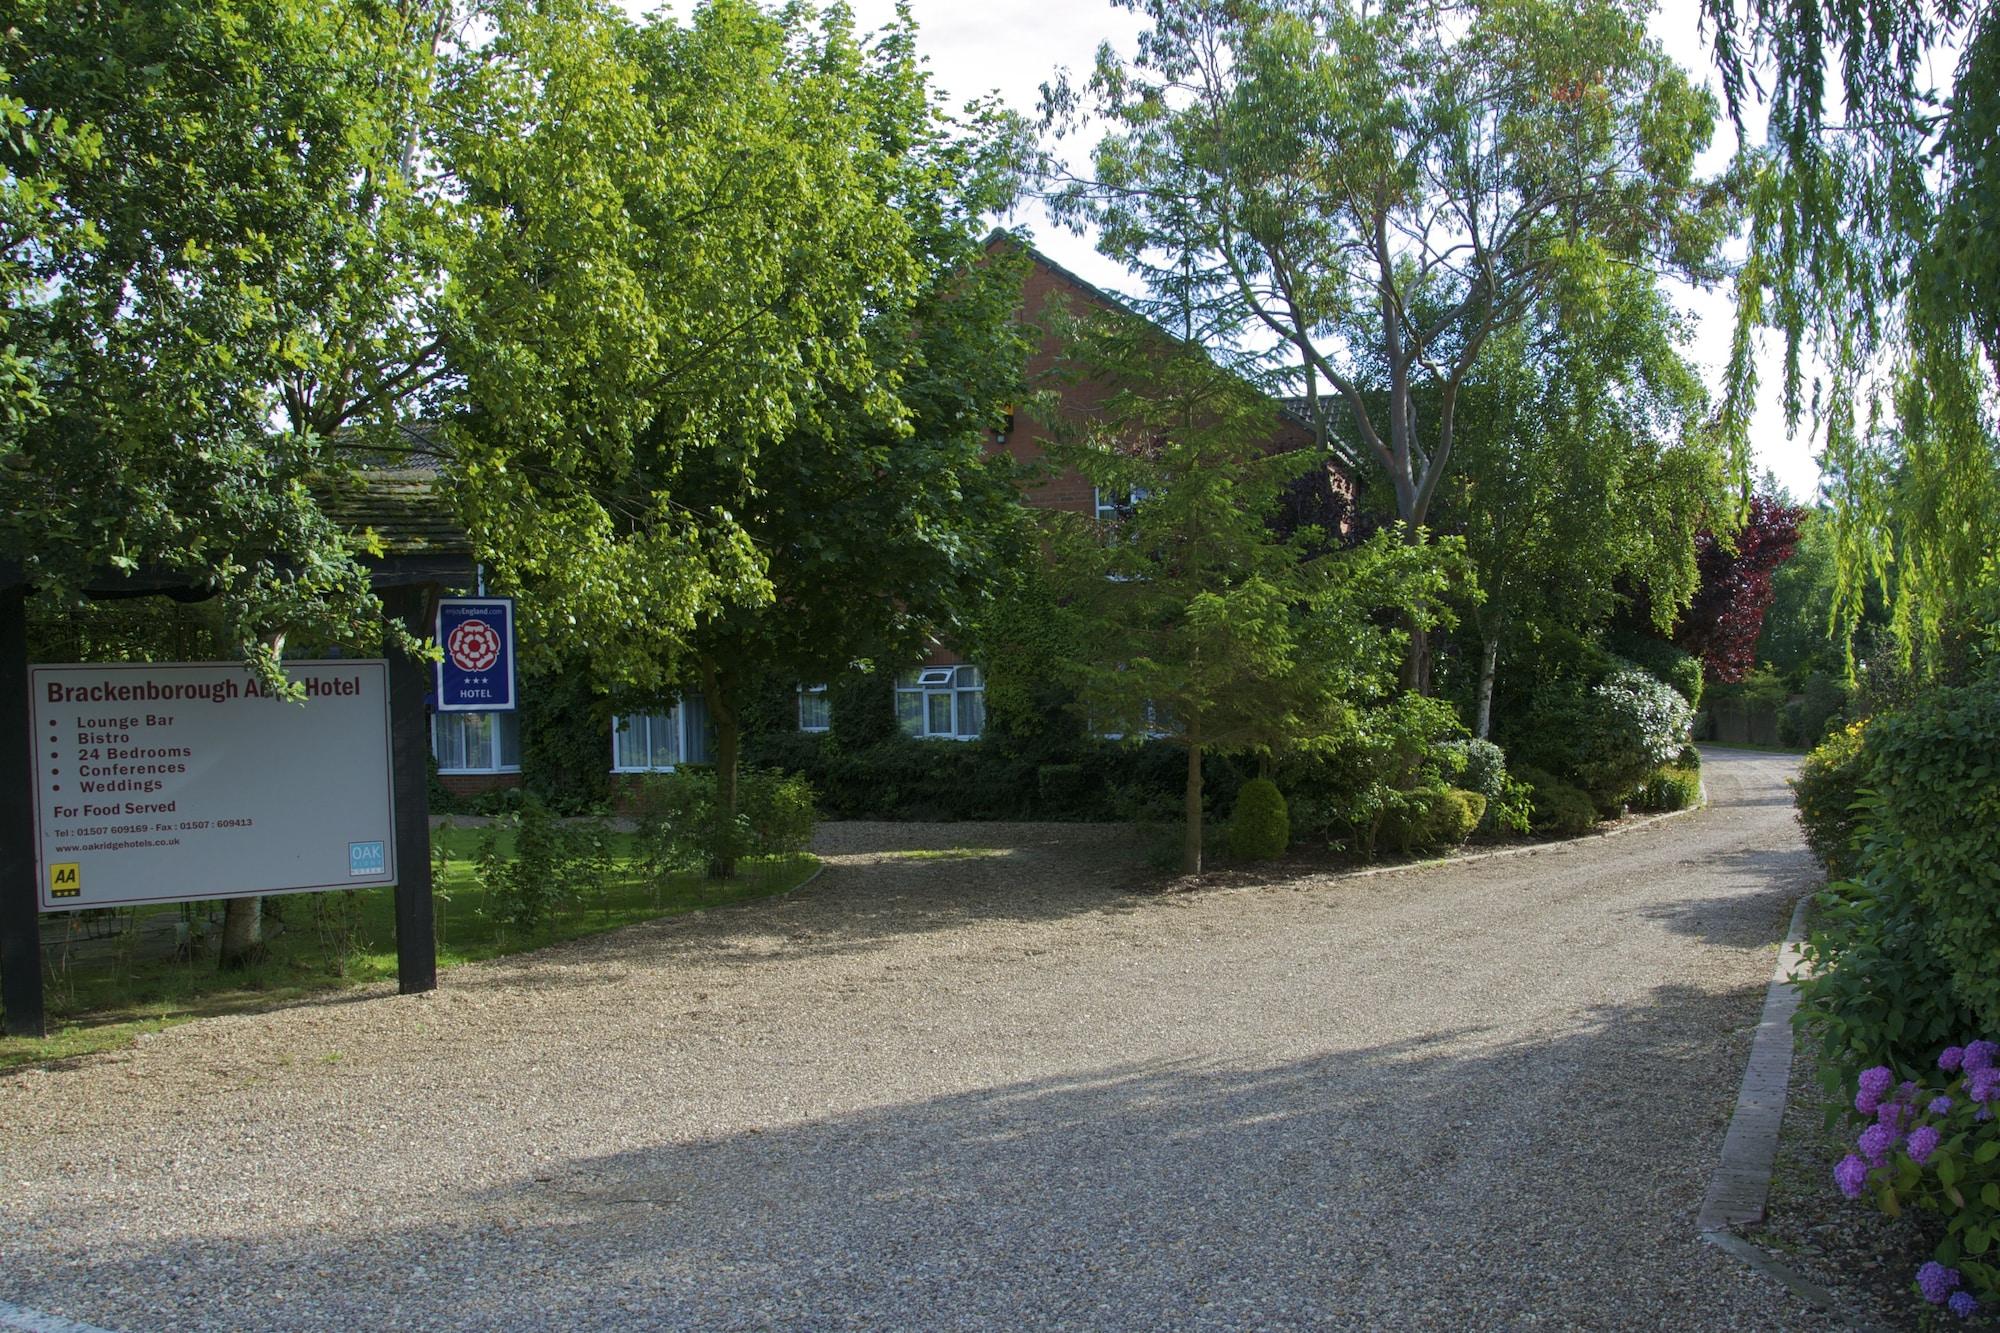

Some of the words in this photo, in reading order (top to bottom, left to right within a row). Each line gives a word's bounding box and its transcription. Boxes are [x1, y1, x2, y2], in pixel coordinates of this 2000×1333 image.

[47, 679, 238, 703] Brackenborough
[305, 676, 360, 696] Hotel
[460, 689, 493, 698] HOTEL
[77, 716, 139, 730] Lounge
[146, 714, 174, 726] Bar
[78, 732, 129, 744] Bistro
[78, 748, 100, 760] 24
[107, 746, 192, 760] Bedrooms
[79, 763, 186, 777] Conferences
[80, 779, 163, 793] Weddings
[54, 806, 79, 818] For
[83, 803, 120, 817] Food
[125, 800, 176, 814] Served
[77, 826, 108, 837] 01507
[180, 820, 210, 830] 01507
[217, 818, 253, 828] 609413
[55, 838, 180, 853] www.oakridgehotels.co.uk
[352, 845, 382, 860] OAK
[54, 868, 77, 884] AA
